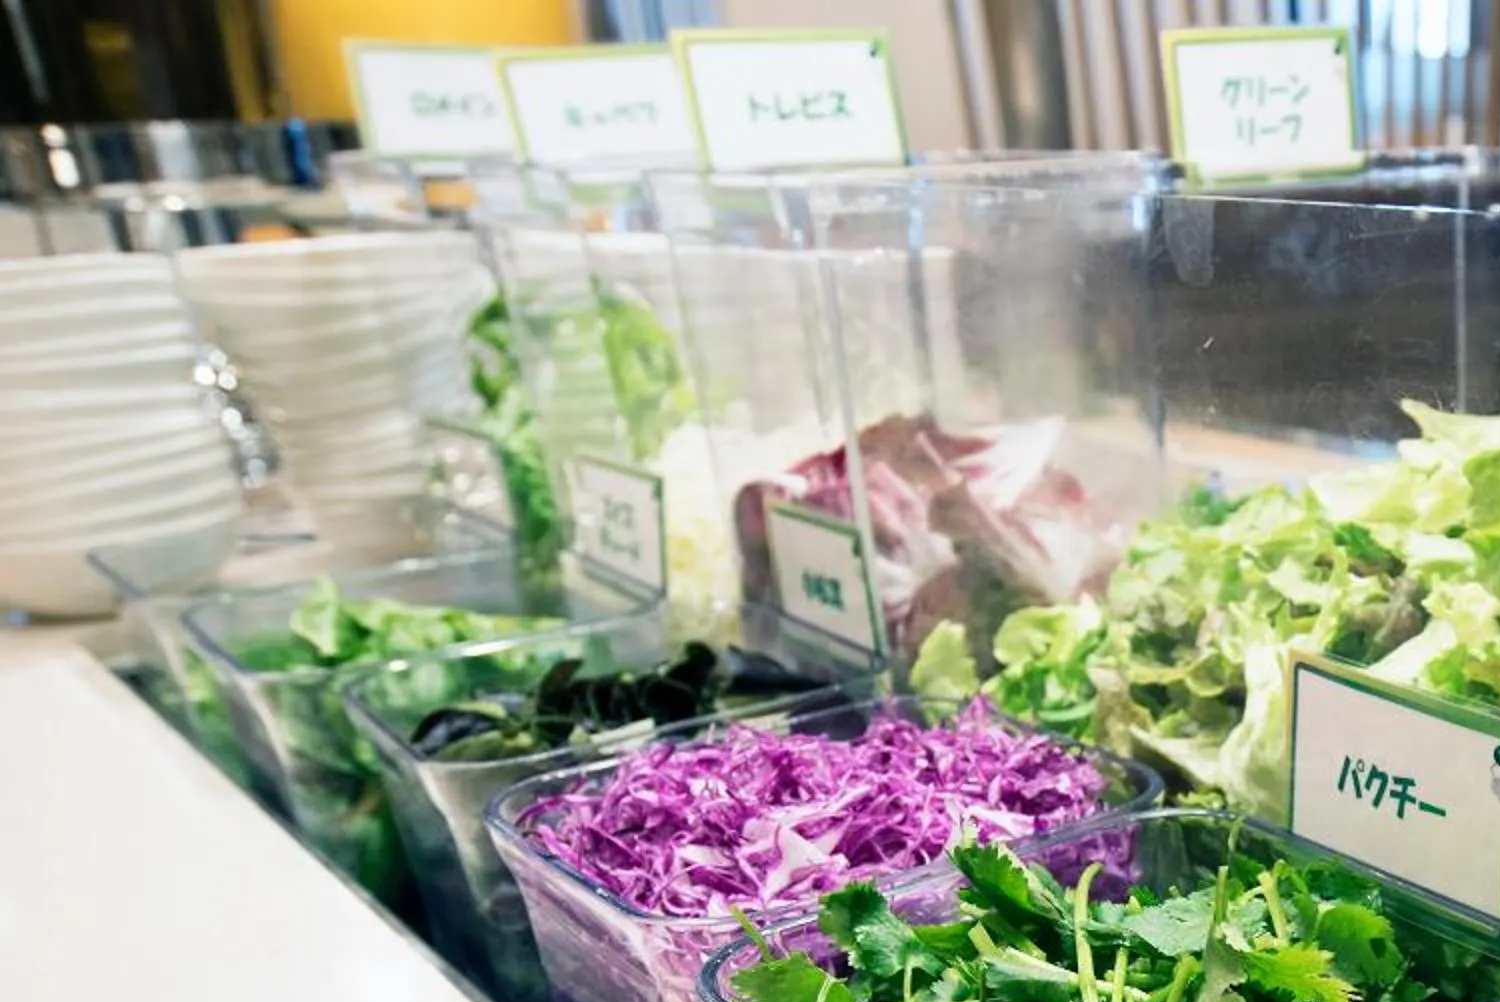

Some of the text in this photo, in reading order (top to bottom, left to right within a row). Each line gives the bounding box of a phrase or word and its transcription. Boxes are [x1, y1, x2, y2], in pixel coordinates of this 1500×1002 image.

[1219, 73, 1311, 107] グリーン
[1235, 113, 1303, 146] リーフ
[1337, 755, 1446, 819] パクチー
